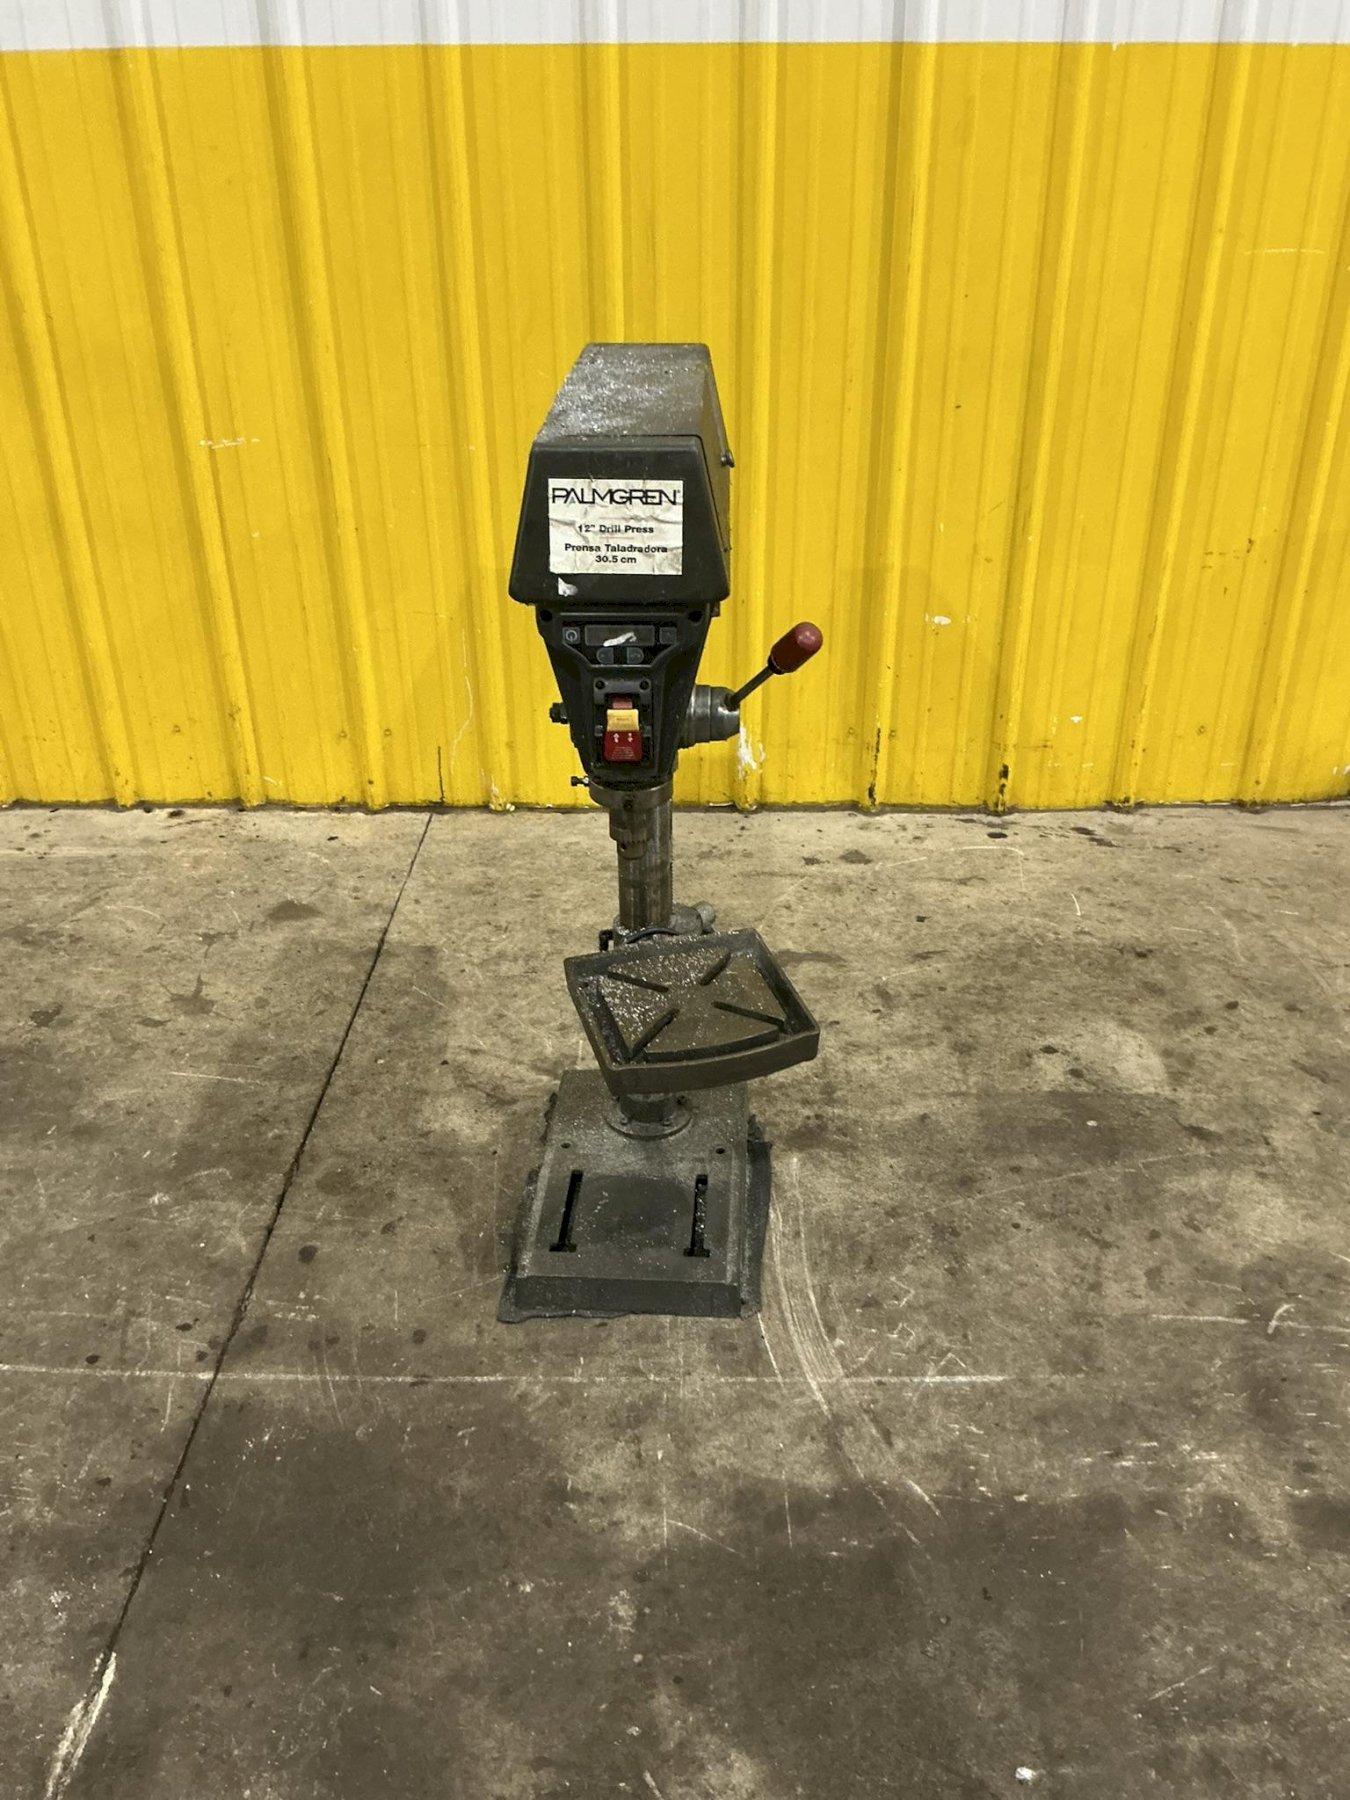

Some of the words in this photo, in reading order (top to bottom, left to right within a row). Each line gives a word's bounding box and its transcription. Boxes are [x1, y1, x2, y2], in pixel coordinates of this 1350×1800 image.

[552, 487, 677, 506] PALMGREN
[599, 524, 621, 533] Drill
[624, 525, 654, 534] Press
[564, 543, 601, 553] Prensa
[605, 544, 668, 553] Taladradora
[595, 555, 618, 564] 30.5
[620, 556, 637, 564] cm
